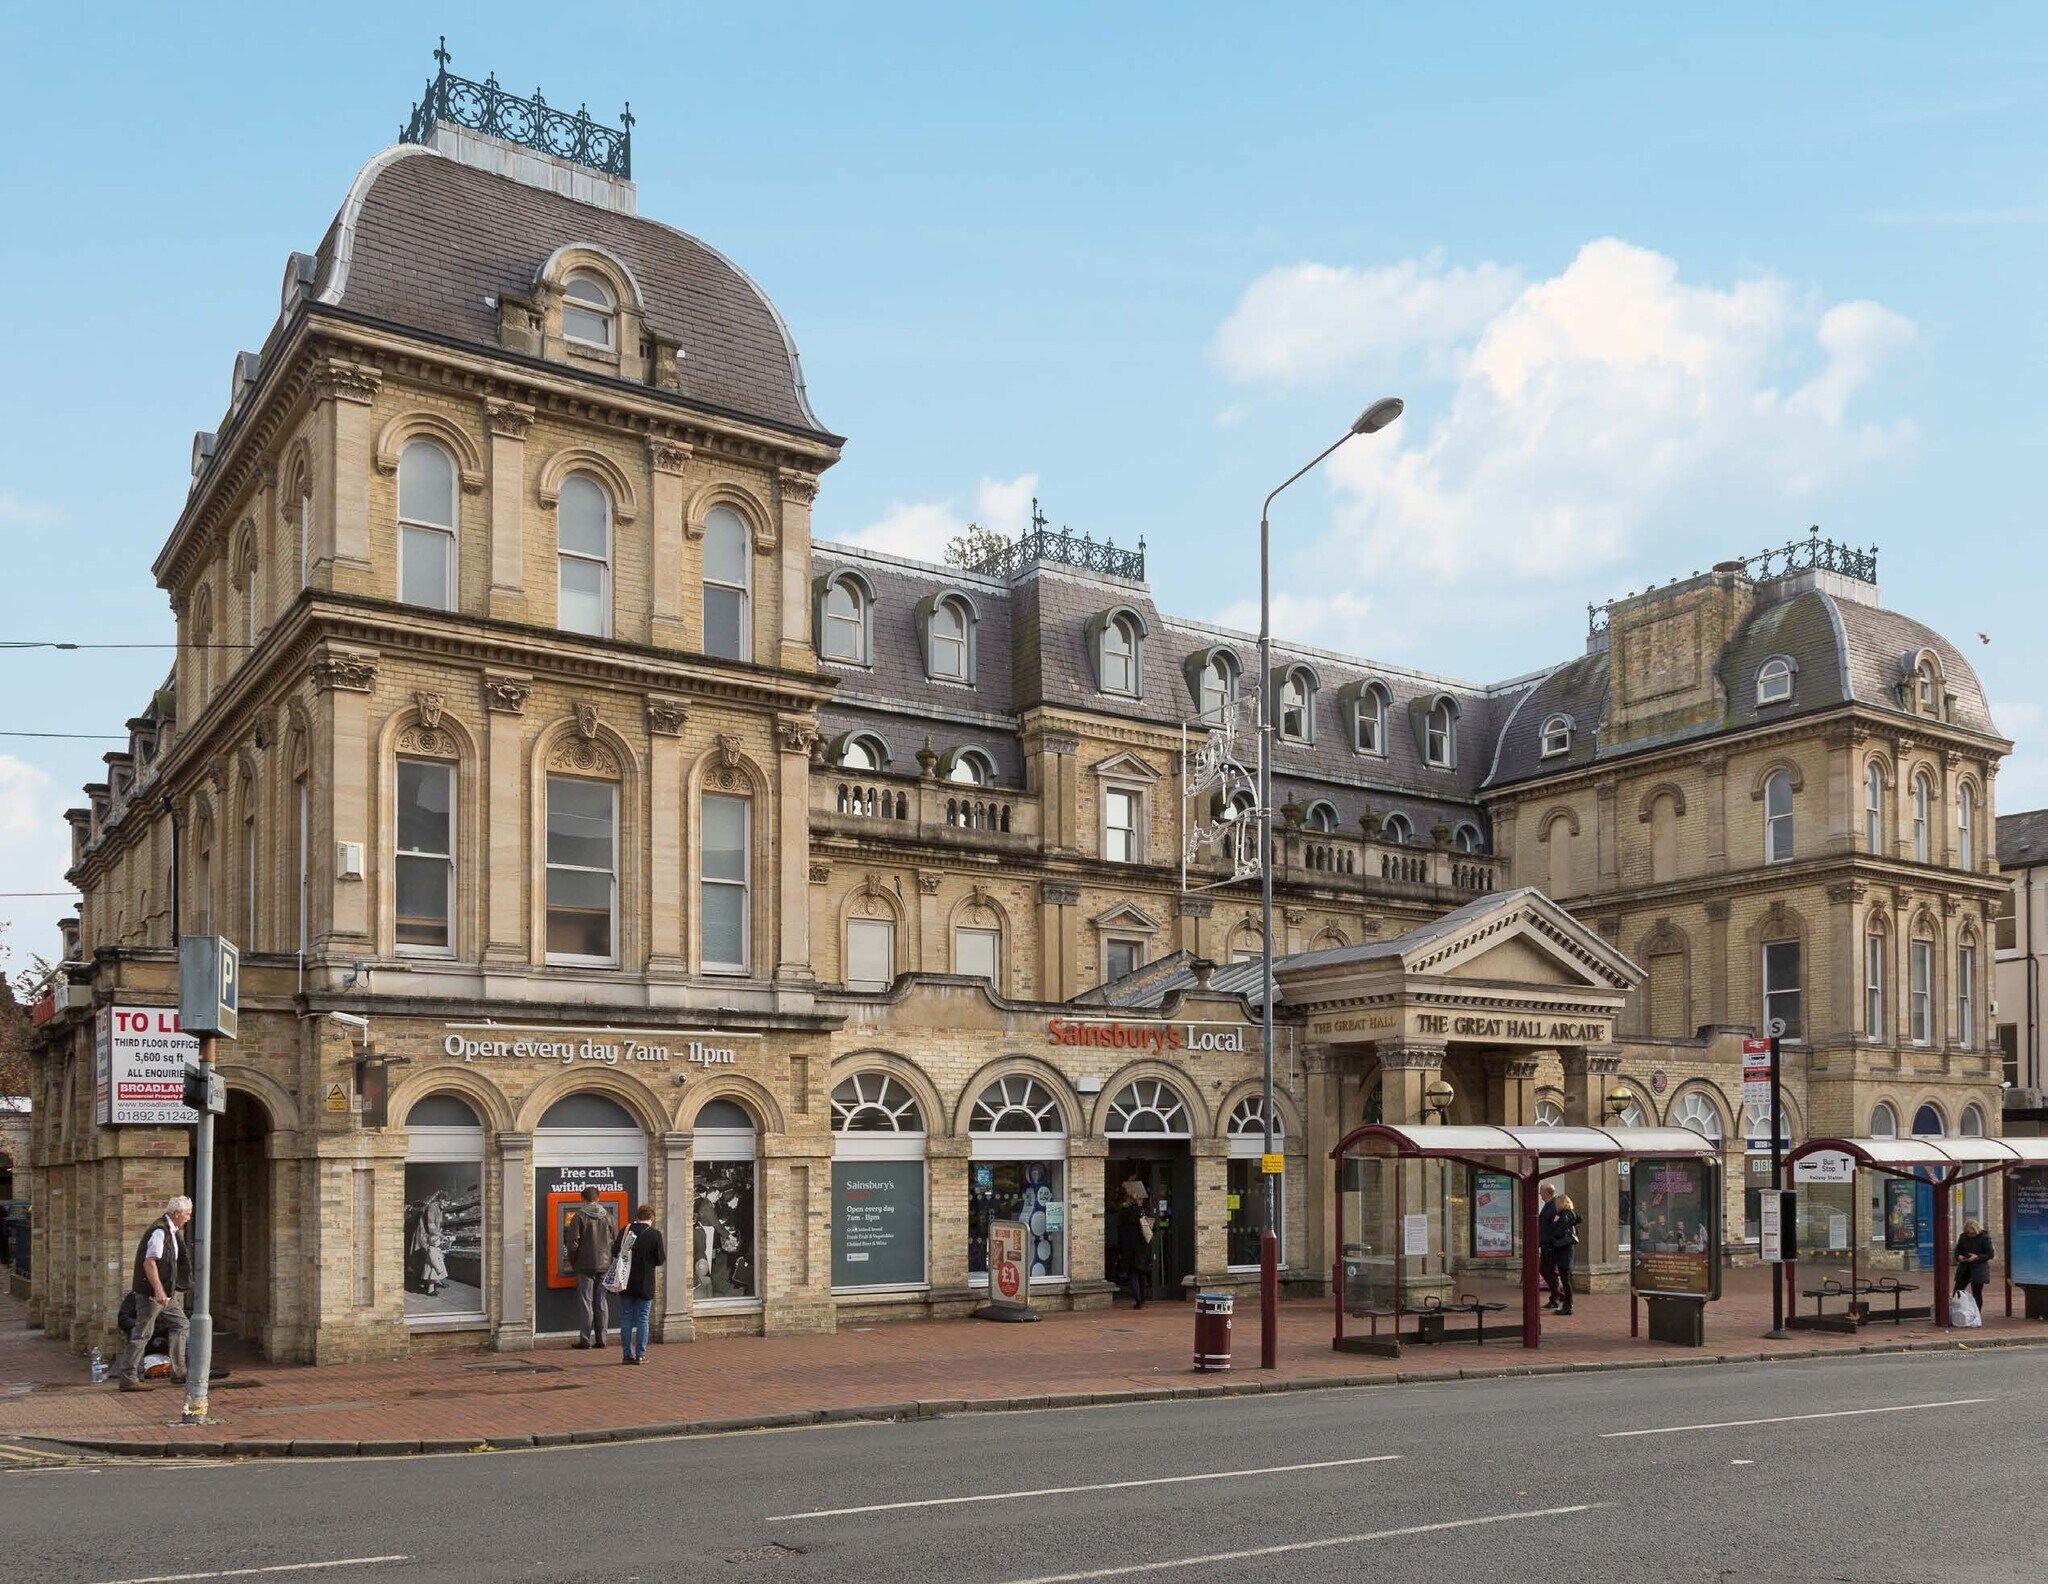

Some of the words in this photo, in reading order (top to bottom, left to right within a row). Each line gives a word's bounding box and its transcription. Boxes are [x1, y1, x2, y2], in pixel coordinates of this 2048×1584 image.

[223, 952, 233, 1000] P
[115, 1012, 148, 1032] TO
[1313, 1022, 1333, 1035] THE
[1334, 1018, 1366, 1033] GREAT
[1369, 1015, 1397, 1029] HALL
[1417, 1014, 1449, 1033] THE
[1454, 1017, 1503, 1036] GREAT
[1507, 1020, 1546, 1039] HALL
[1550, 1021, 1606, 1042] ARCADE
[1771, 1021, 1781, 1034] S
[114, 1038, 139, 1048] THIRD
[141, 1039, 168, 1048] FLOOR
[170, 1039, 199, 1049] OFFICE
[1048, 1018, 1183, 1057] Sainsbury's
[1187, 1024, 1244, 1052] Local
[445, 1034, 508, 1063] Open
[513, 1039, 575, 1064] every
[579, 1038, 619, 1065] day
[623, 1040, 668, 1062] 7am
[688, 1041, 736, 1068] 11pm
[135, 1052, 160, 1064] 5,600
[163, 1054, 173, 1063] sq
[175, 1052, 184, 1062] ft
[127, 1068, 142, 1078] ALL
[145, 1069, 185, 1078] ENQUIRIE
[120, 1084, 184, 1093] BROADLAN
[117, 1111, 154, 1121] 01892
[158, 1111, 199, 1121] 512422
[1821, 1165, 1836, 1173] Stop
[1840, 1158, 1849, 1171] T
[560, 1167, 586, 1178] Free
[588, 1167, 615, 1178] cash
[846, 1180, 895, 1191] Sainsbury's
[846, 1205, 864, 1213] Open
[883, 1205, 895, 1213] day
[1001, 1266, 1016, 1284] £1
